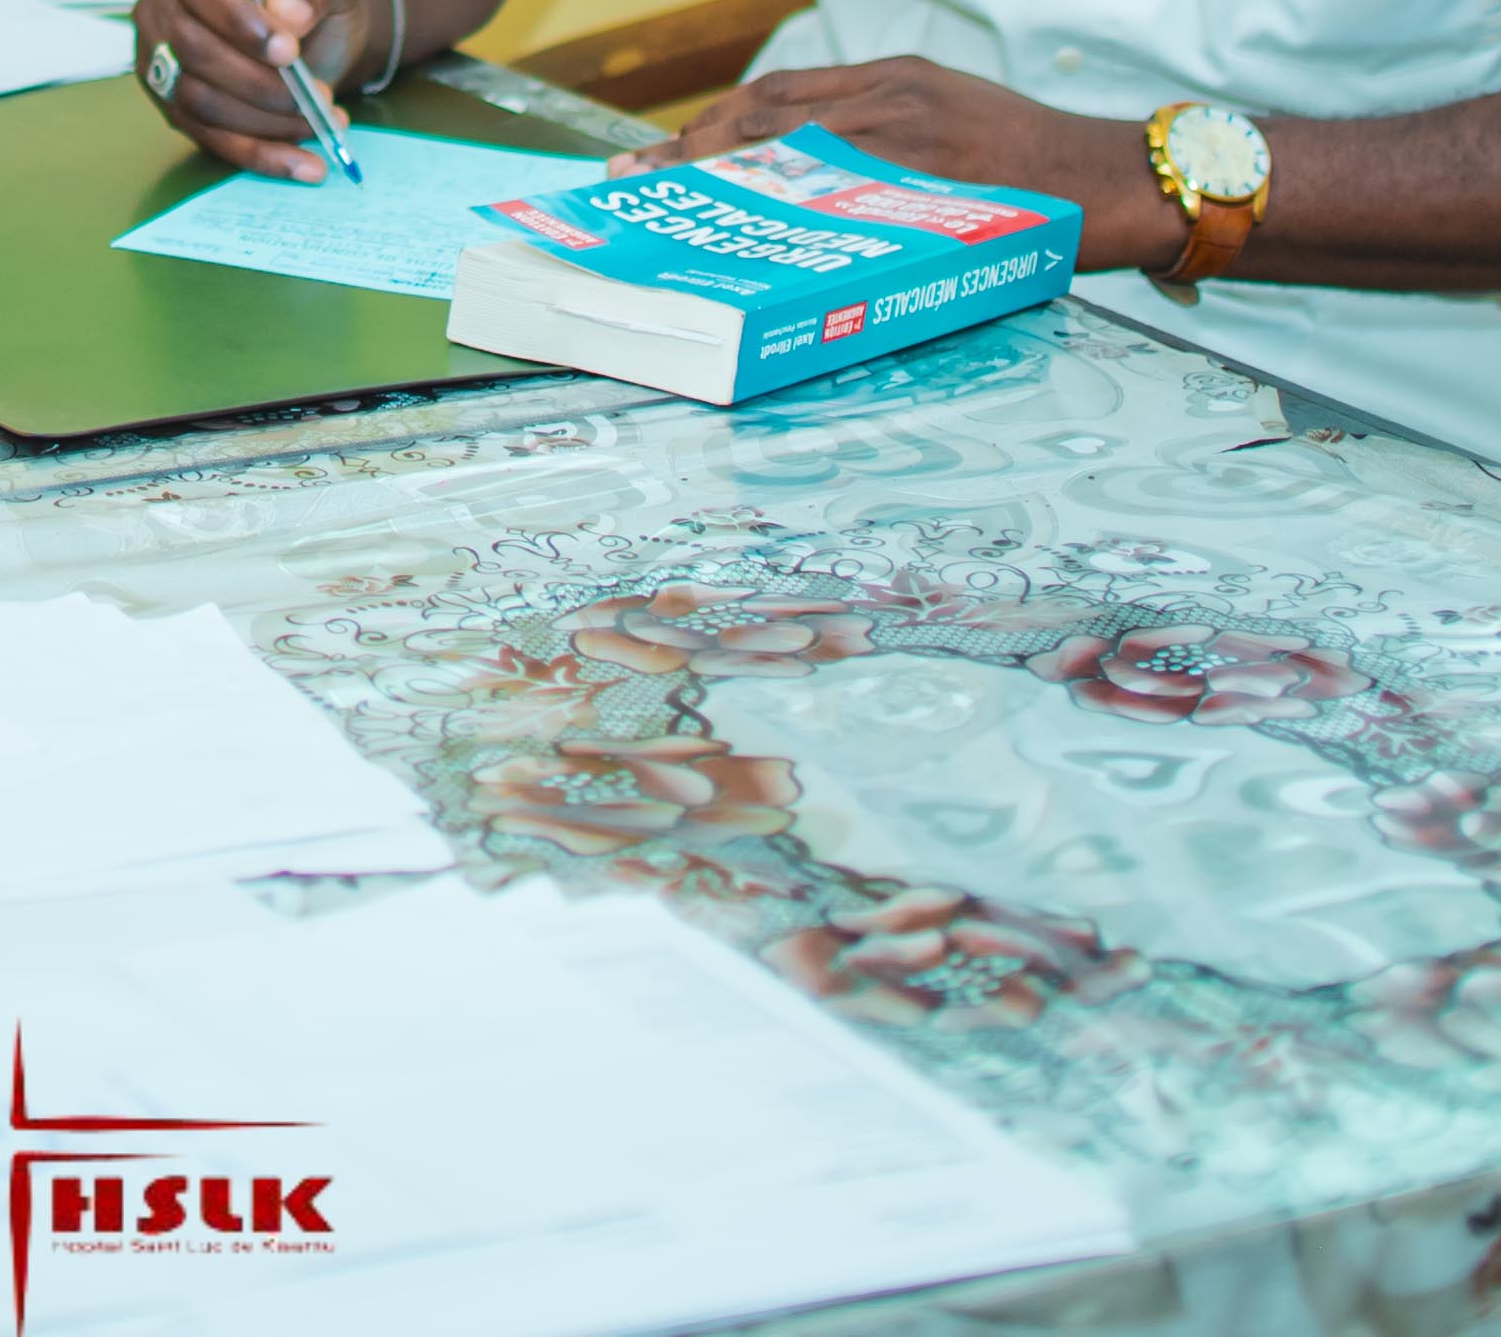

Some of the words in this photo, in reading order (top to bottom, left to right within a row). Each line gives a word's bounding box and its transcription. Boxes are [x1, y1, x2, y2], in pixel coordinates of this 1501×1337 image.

[590, 190, 852, 274] URGENCES
[639, 180, 903, 261] MÉDICALES
[962, 251, 1039, 296] URGENCES
[872, 276, 959, 325] MÉDICALES
[792, 331, 816, 351] Axel
